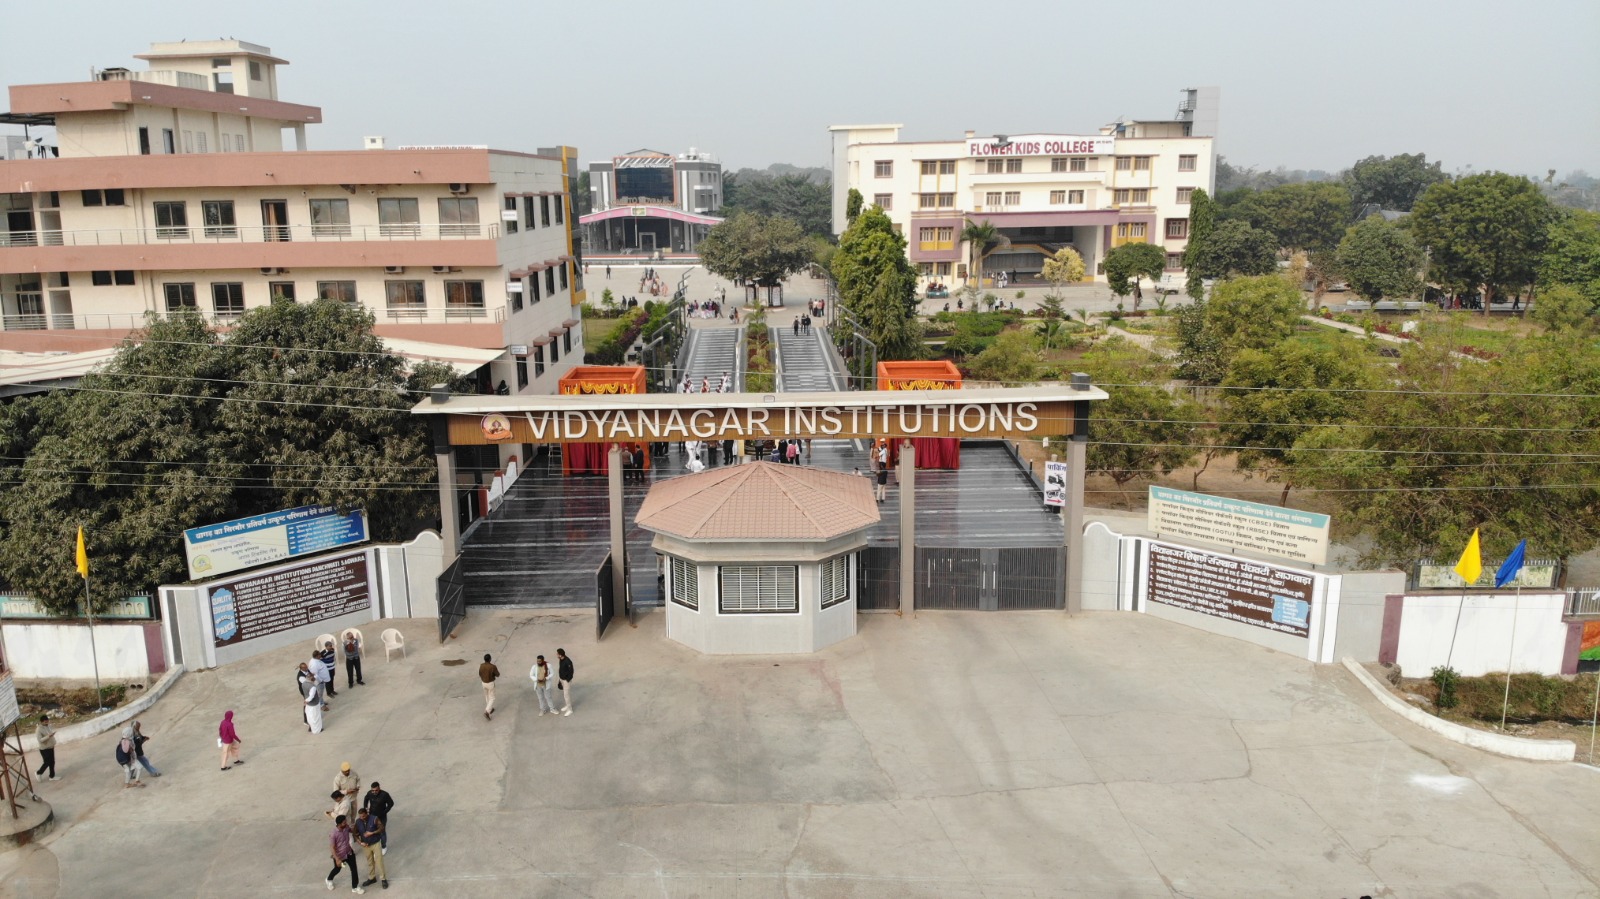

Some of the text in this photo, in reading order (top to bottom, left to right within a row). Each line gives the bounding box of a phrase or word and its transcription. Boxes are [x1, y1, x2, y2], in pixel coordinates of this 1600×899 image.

[970, 140, 1094, 155] FLOWER KIDS COLLEGE
[526, 402, 1038, 440] VIDYANAGAR INSTITUTIONS
[1206, 555, 1237, 570] संस्थान
[1239, 562, 1269, 576] पंचवटी
[234, 576, 272, 590] VIDYANAGAR
[273, 567, 311, 581] INSTITUTIONS
